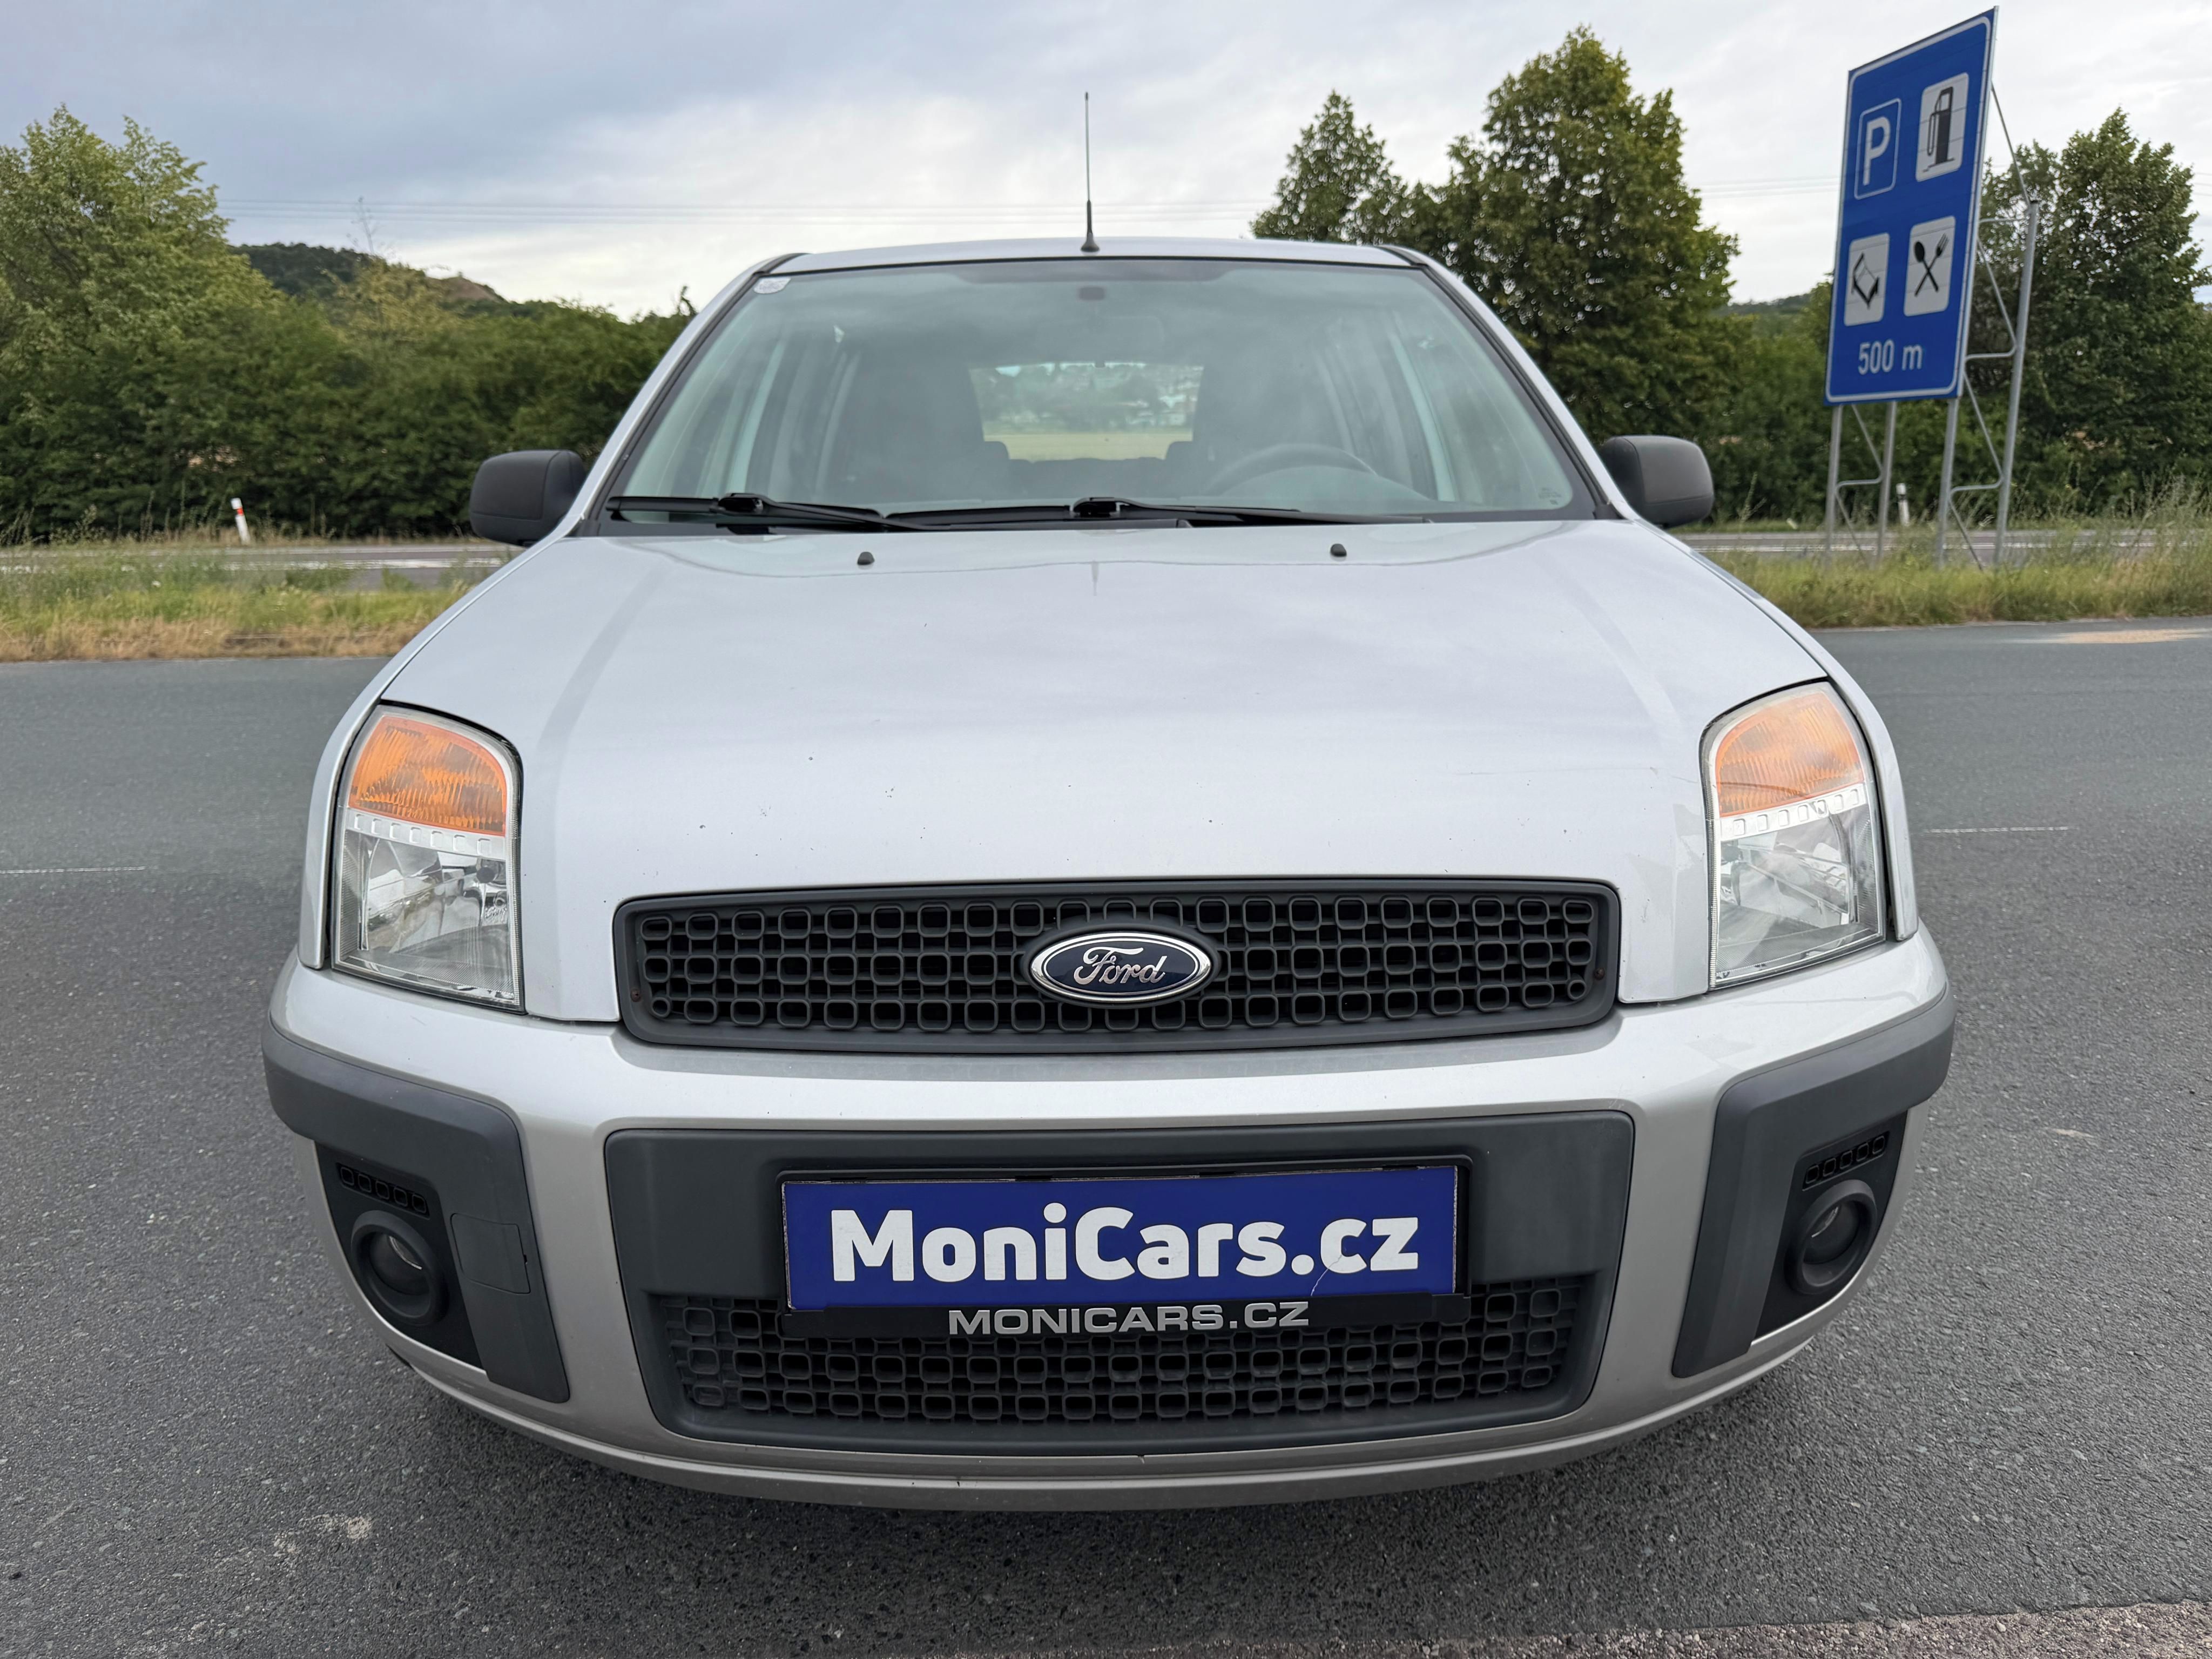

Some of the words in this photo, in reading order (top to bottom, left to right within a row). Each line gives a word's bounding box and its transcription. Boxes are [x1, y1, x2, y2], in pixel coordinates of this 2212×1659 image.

[1863, 116, 1891, 186] P
[1858, 339, 1894, 375] 500
[1901, 345, 1923, 370] m
[1074, 946, 1167, 984] Ford
[831, 1202, 1419, 1283] MoniCars.cz
[948, 1301, 1309, 1335] MONICARS.CZ
